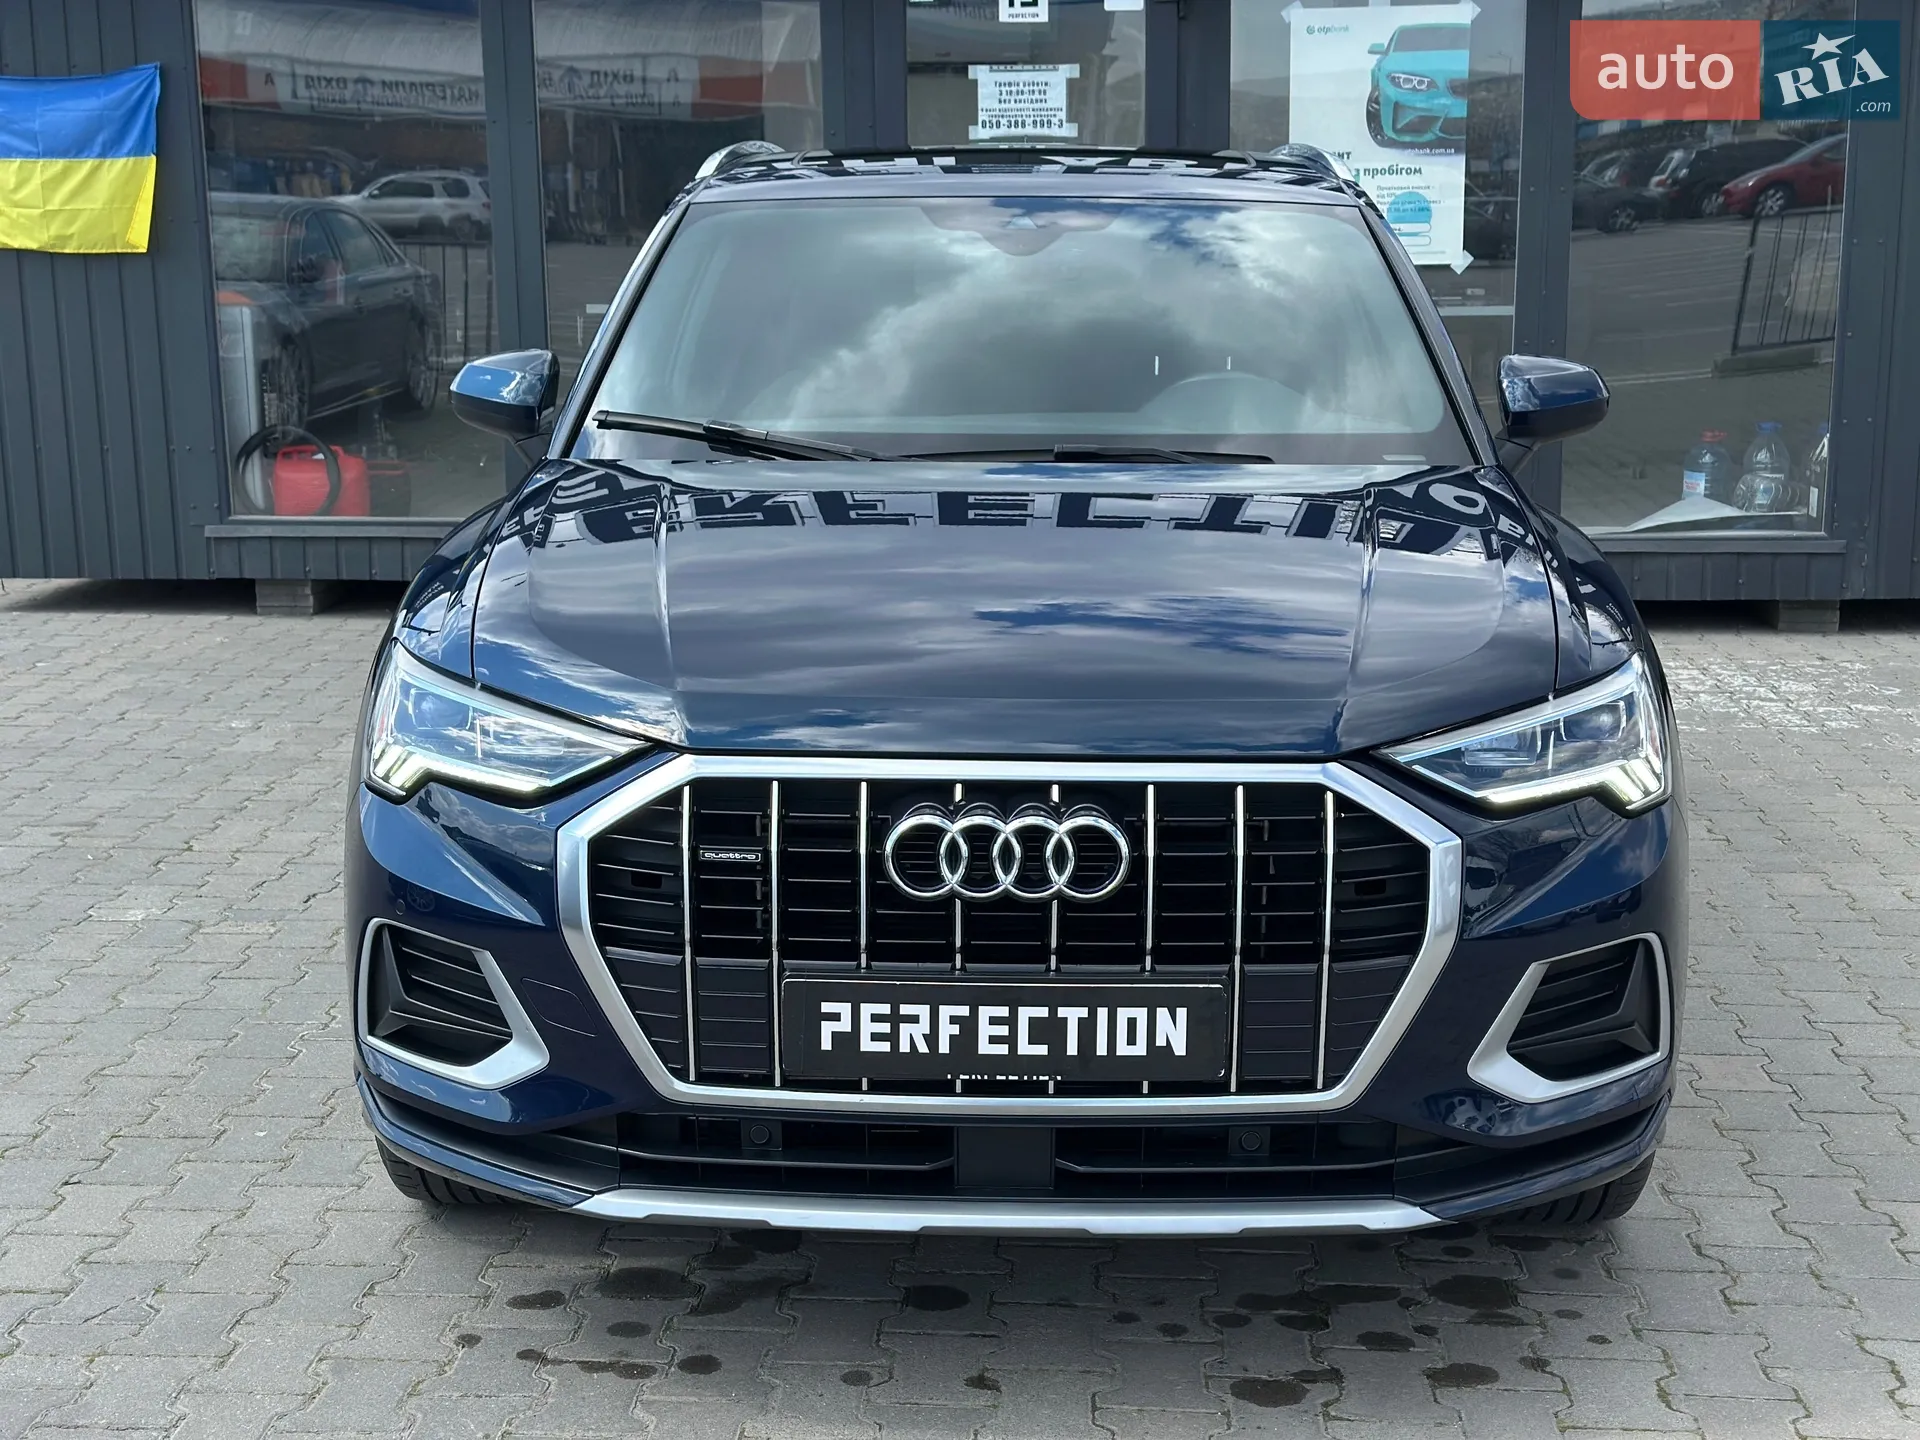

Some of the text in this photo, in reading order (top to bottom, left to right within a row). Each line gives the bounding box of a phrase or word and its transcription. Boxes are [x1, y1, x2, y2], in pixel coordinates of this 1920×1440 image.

[1364, 164, 1422, 178] пробігом
[704, 852, 756, 860] quattro
[820, 1002, 1188, 1056] PERFECTION
